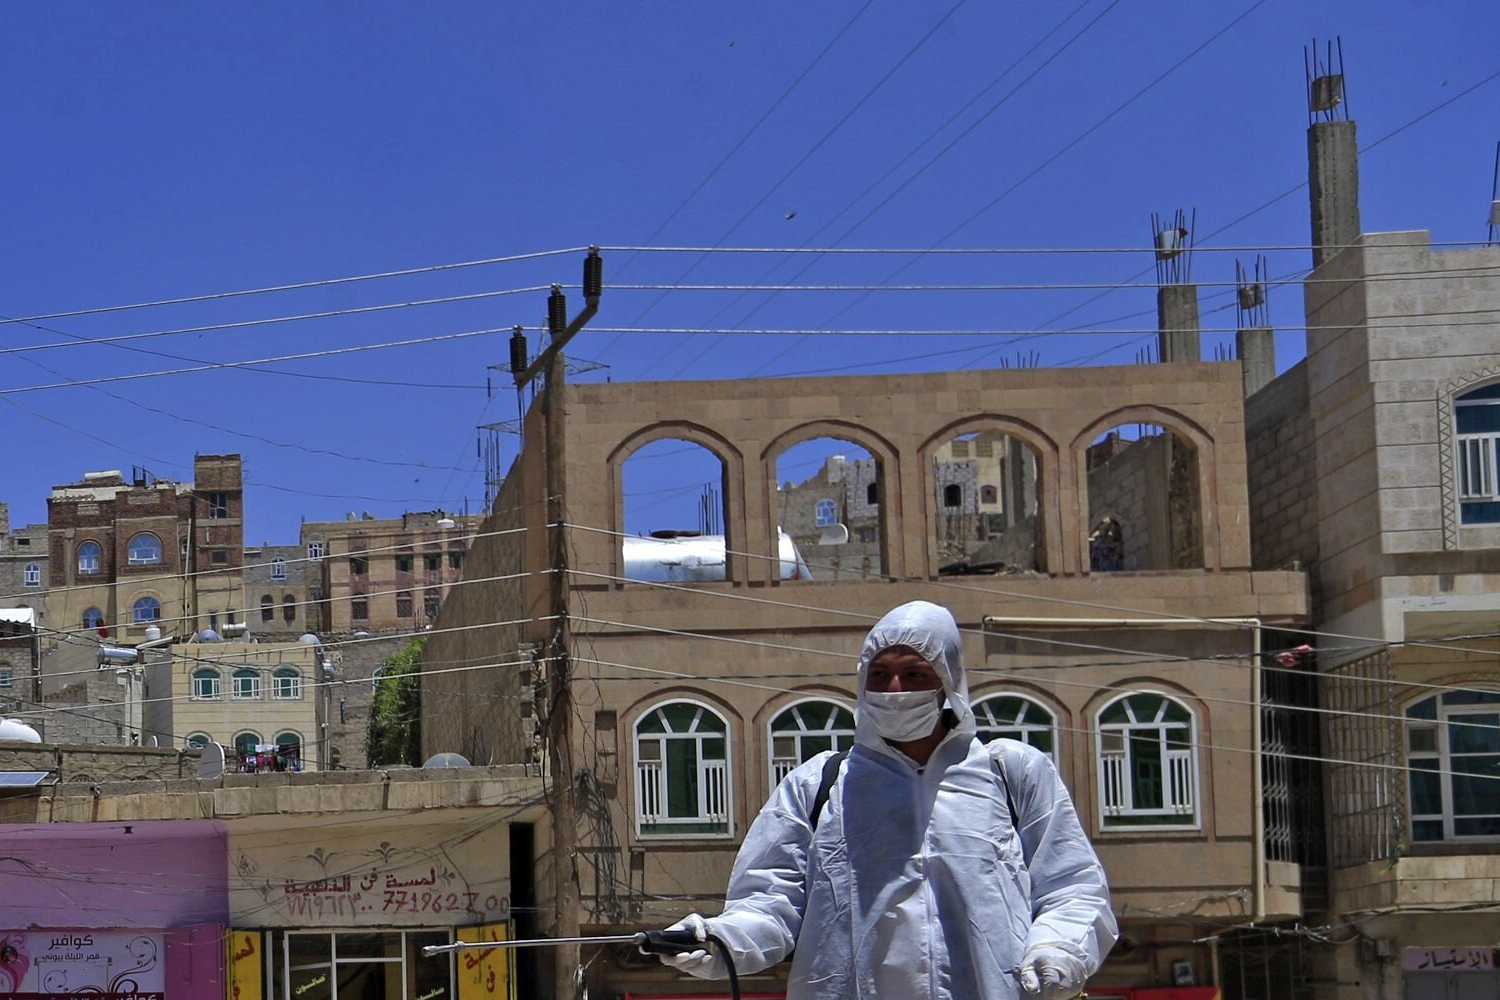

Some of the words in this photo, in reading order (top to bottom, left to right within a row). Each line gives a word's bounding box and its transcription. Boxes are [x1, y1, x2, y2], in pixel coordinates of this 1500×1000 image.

[360, 867, 379, 891] فن
[386, 868, 436, 889] لمسة
[48, 934, 94, 950] كوافير
[65, 953, 84, 961] الليلة
[86, 953, 100, 962] قمر
[295, 973, 326, 996] صالون
[486, 964, 496, 993] فن
